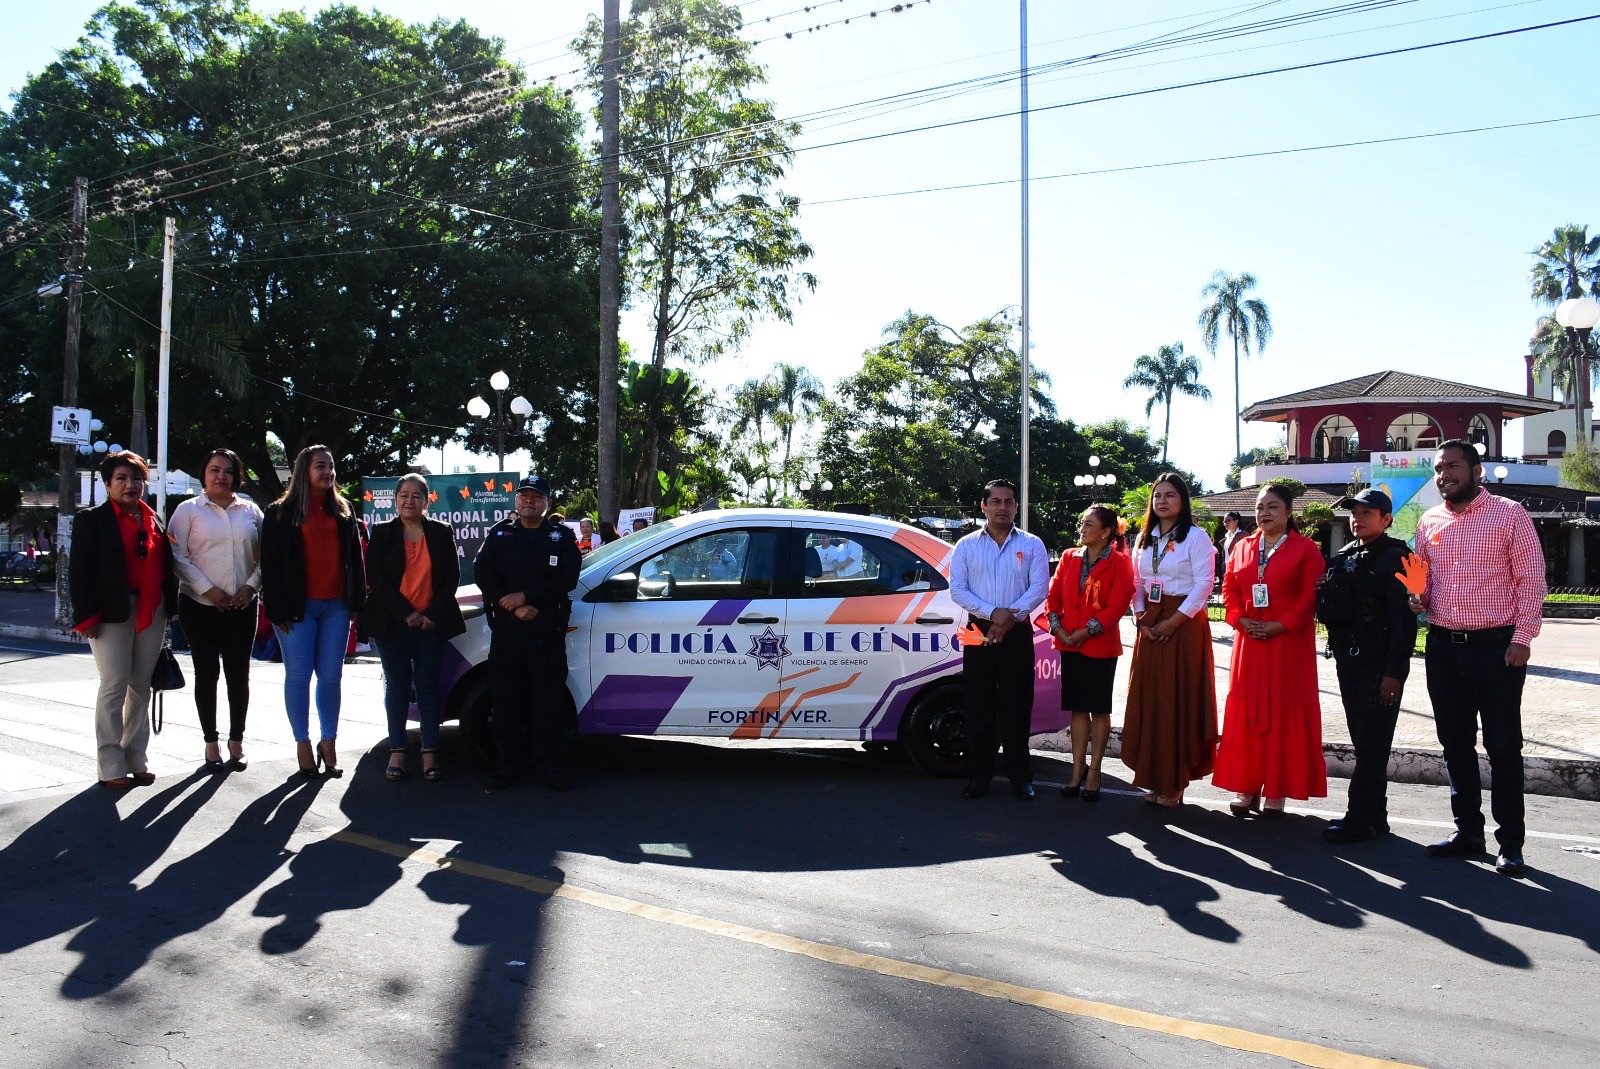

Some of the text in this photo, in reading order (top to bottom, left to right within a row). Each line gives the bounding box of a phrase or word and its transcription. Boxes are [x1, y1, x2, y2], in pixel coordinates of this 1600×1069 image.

[372, 488, 394, 496] FORTÍN
[605, 628, 738, 654] POLICÍA
[803, 632, 843, 652] DE
[840, 658, 869, 666] GÉNERO
[708, 708, 832, 724] FORTÍN, VER.
